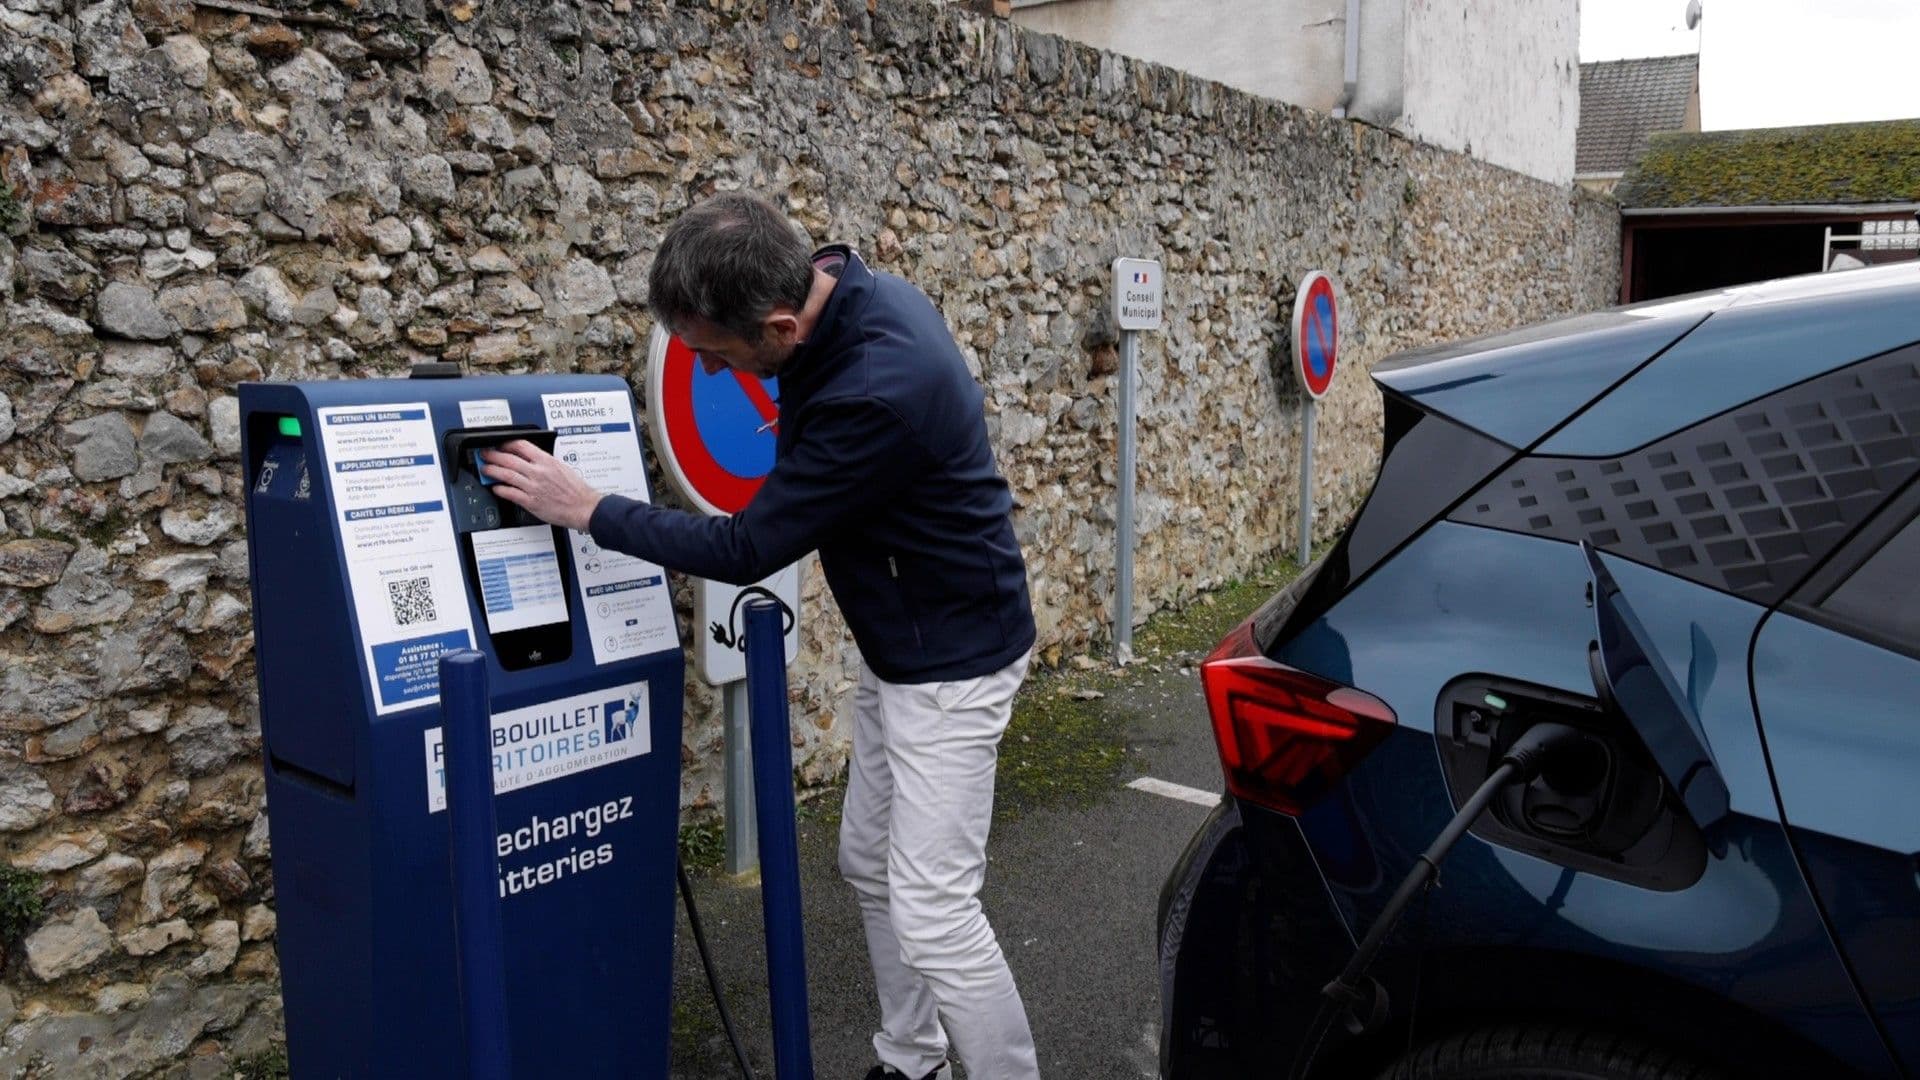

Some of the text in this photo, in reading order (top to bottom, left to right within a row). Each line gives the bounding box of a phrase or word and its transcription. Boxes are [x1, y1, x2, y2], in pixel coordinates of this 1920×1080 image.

[1126, 290, 1155, 303] Conseil
[1122, 306, 1159, 319] Municipal
[548, 397, 597, 408] COMMENT
[332, 412, 401, 424] OBTENIR UN BADGE
[566, 407, 606, 419] MARCHE
[557, 427, 573, 435] AVEC
[341, 457, 415, 471] APPLICATION MOBILE
[350, 509, 374, 519] CARTE
[375, 507, 387, 515] DU
[402, 643, 440, 655] Assistance
[398, 656, 408, 664] 01
[420, 651, 429, 660] 77
[430, 649, 440, 658] 01
[526, 746, 629, 782] D'AGGLOMÉRATION
[496, 796, 633, 857] echargez
